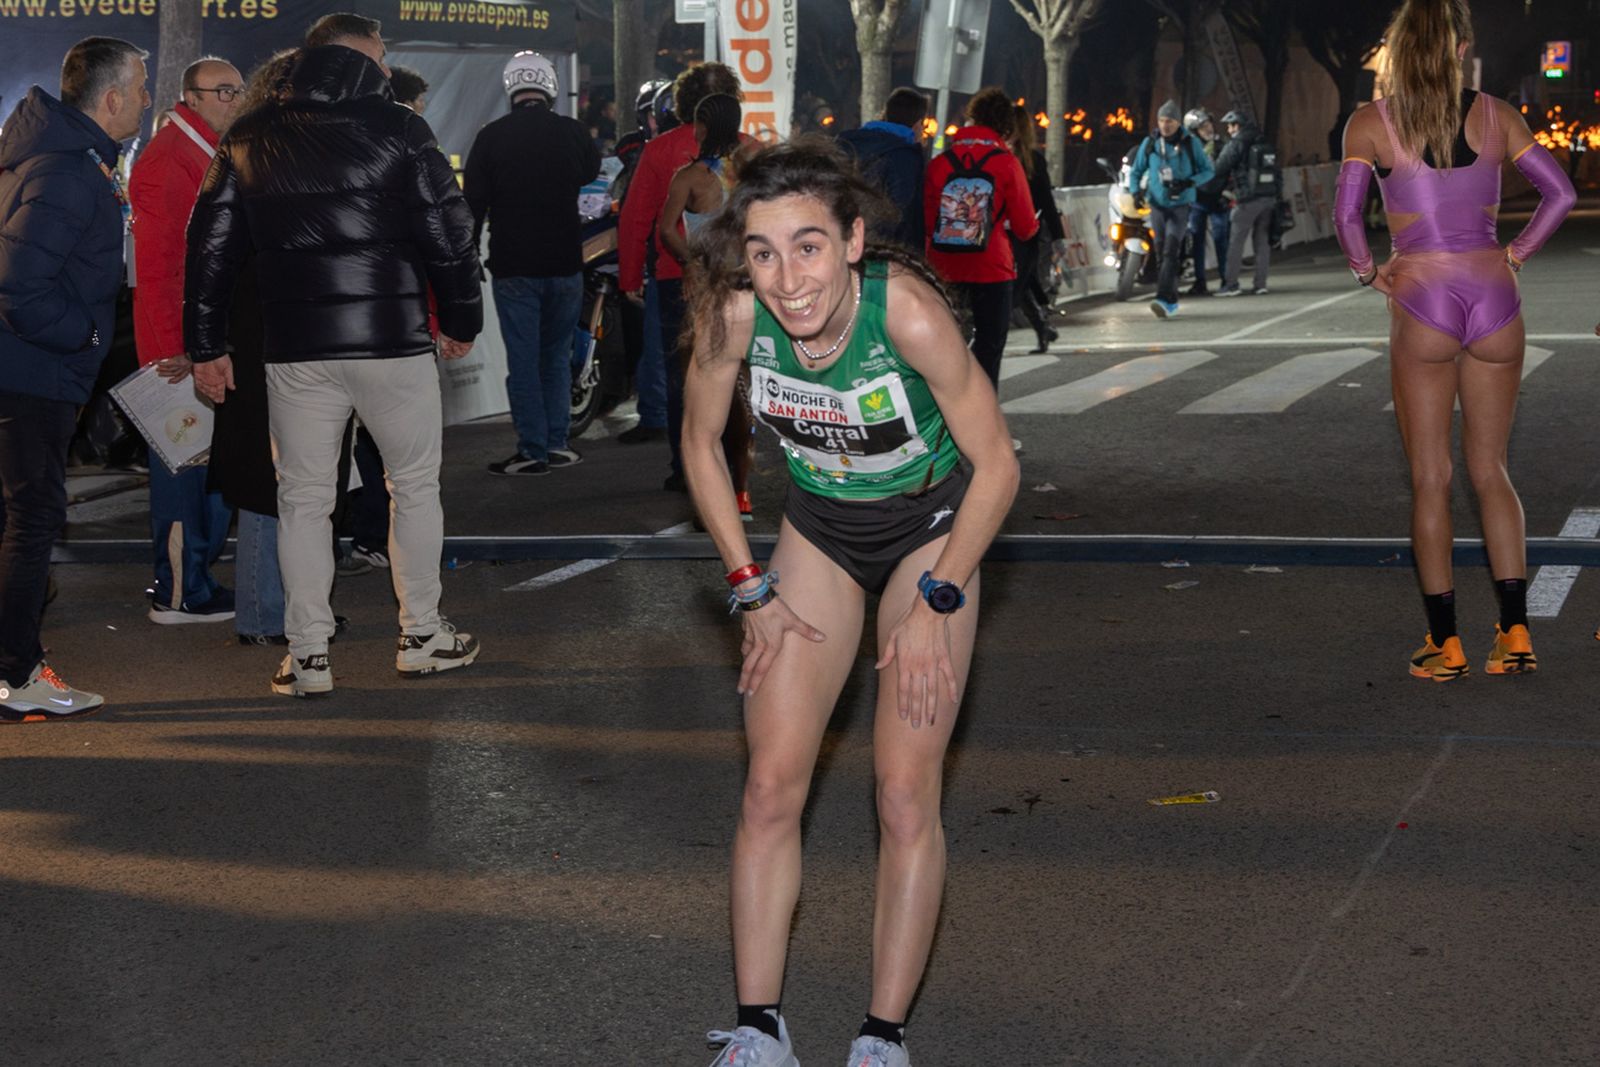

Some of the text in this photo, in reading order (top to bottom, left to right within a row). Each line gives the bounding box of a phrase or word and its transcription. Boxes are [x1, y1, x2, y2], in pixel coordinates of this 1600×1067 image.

[398, 1, 551, 31] www.evedeport.es
[781, 390, 828, 408] NOCHE
[830, 398, 845, 412] DE
[767, 400, 849, 425] SAN ANTÓN
[792, 419, 870, 441] Corral
[825, 437, 848, 450] 41
